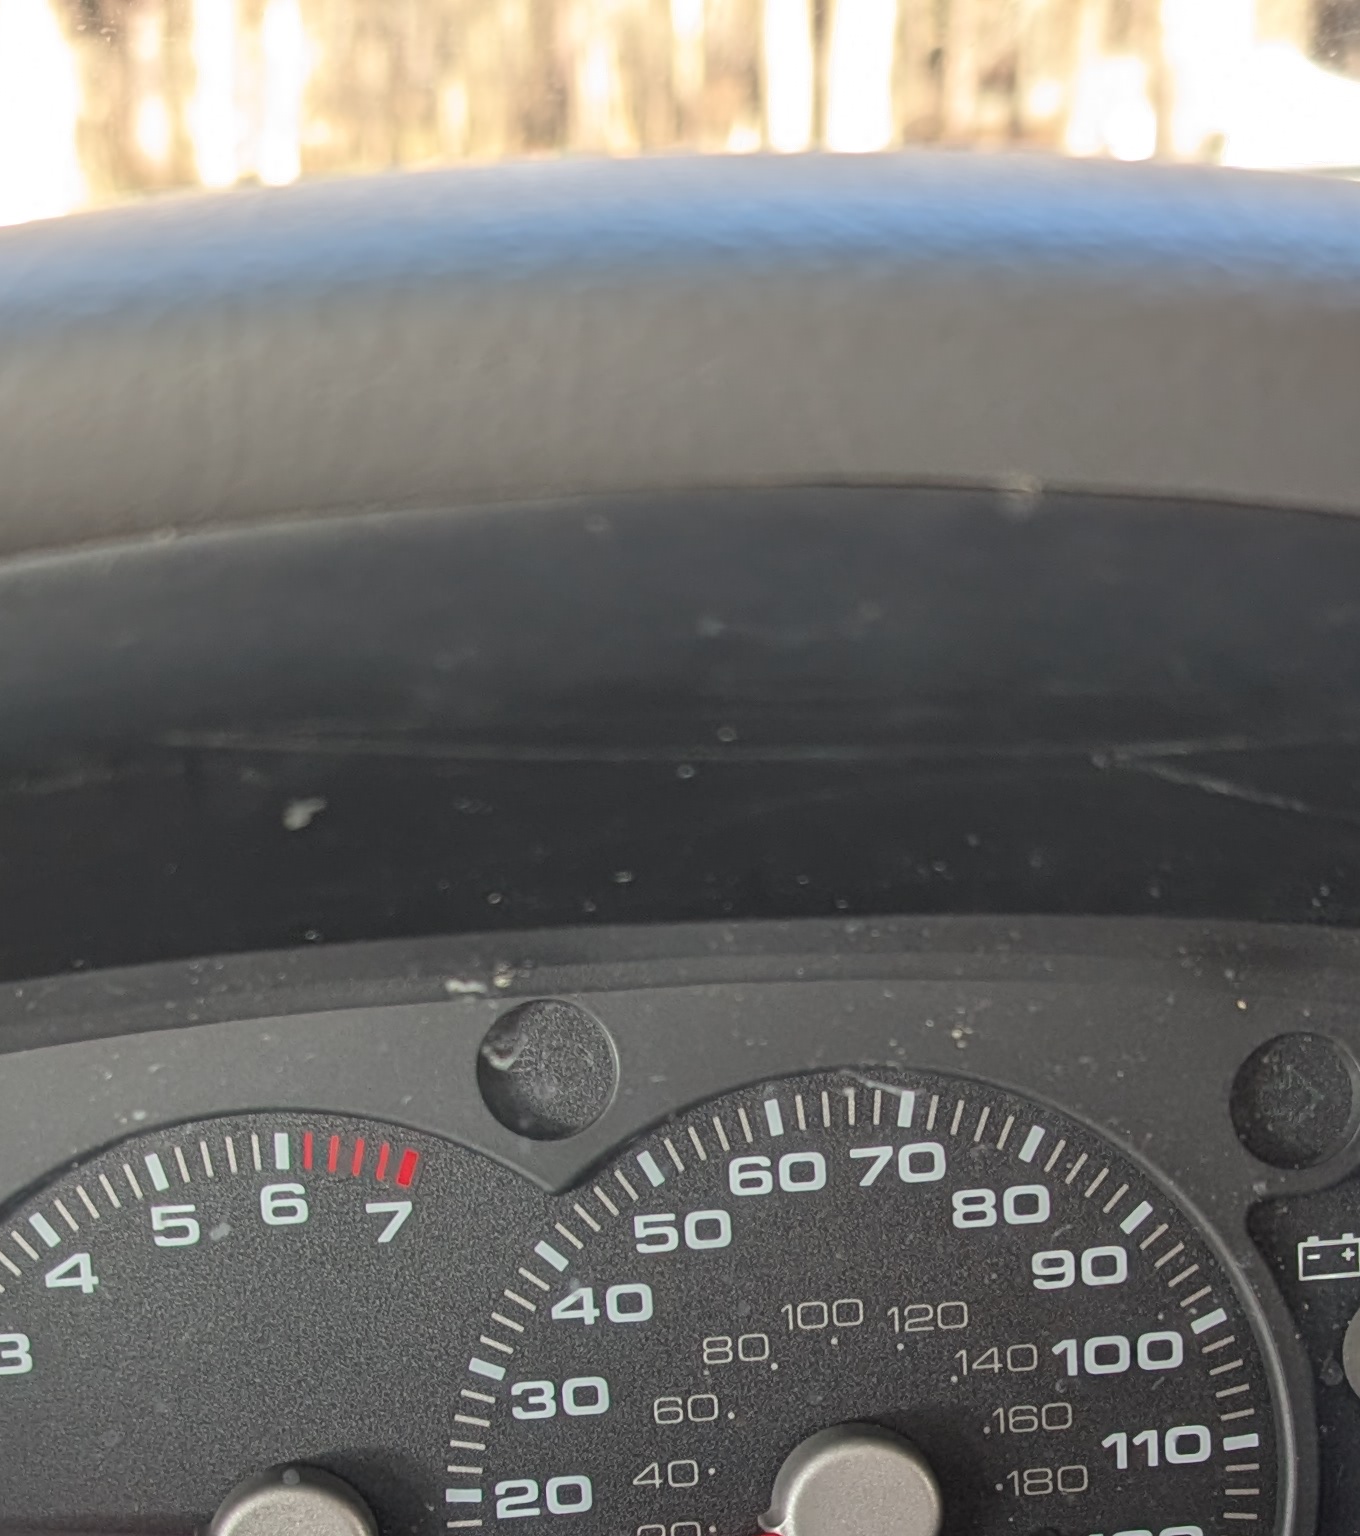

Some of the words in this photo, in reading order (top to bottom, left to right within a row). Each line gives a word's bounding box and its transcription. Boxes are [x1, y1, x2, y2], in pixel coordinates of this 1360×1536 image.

[728, 1151, 827, 1196] 60
[849, 1141, 947, 1187] 70
[150, 1204, 200, 1247] 5
[259, 1182, 309, 1226] 6
[365, 1200, 413, 1243] 7
[951, 1184, 1051, 1229] 80
[633, 1209, 732, 1254] 50
[44, 1252, 99, 1294] 4
[1031, 1245, 1128, 1290] 90
[551, 1282, 653, 1326] 40
[780, 1298, 864, 1331] 100
[887, 1300, 969, 1334] 120
[702, 1332, 770, 1365] 80
[954, 1343, 1038, 1376] 140
[1051, 1330, 1184, 1377] 100
[510, 1376, 610, 1420] 30
[653, 1393, 719, 1425] 60
[992, 1401, 1073, 1434] 160
[1101, 1424, 1212, 1470] 110
[632, 1459, 699, 1489] 40
[1006, 1464, 1090, 1497] 180
[494, 1475, 593, 1519] 20
